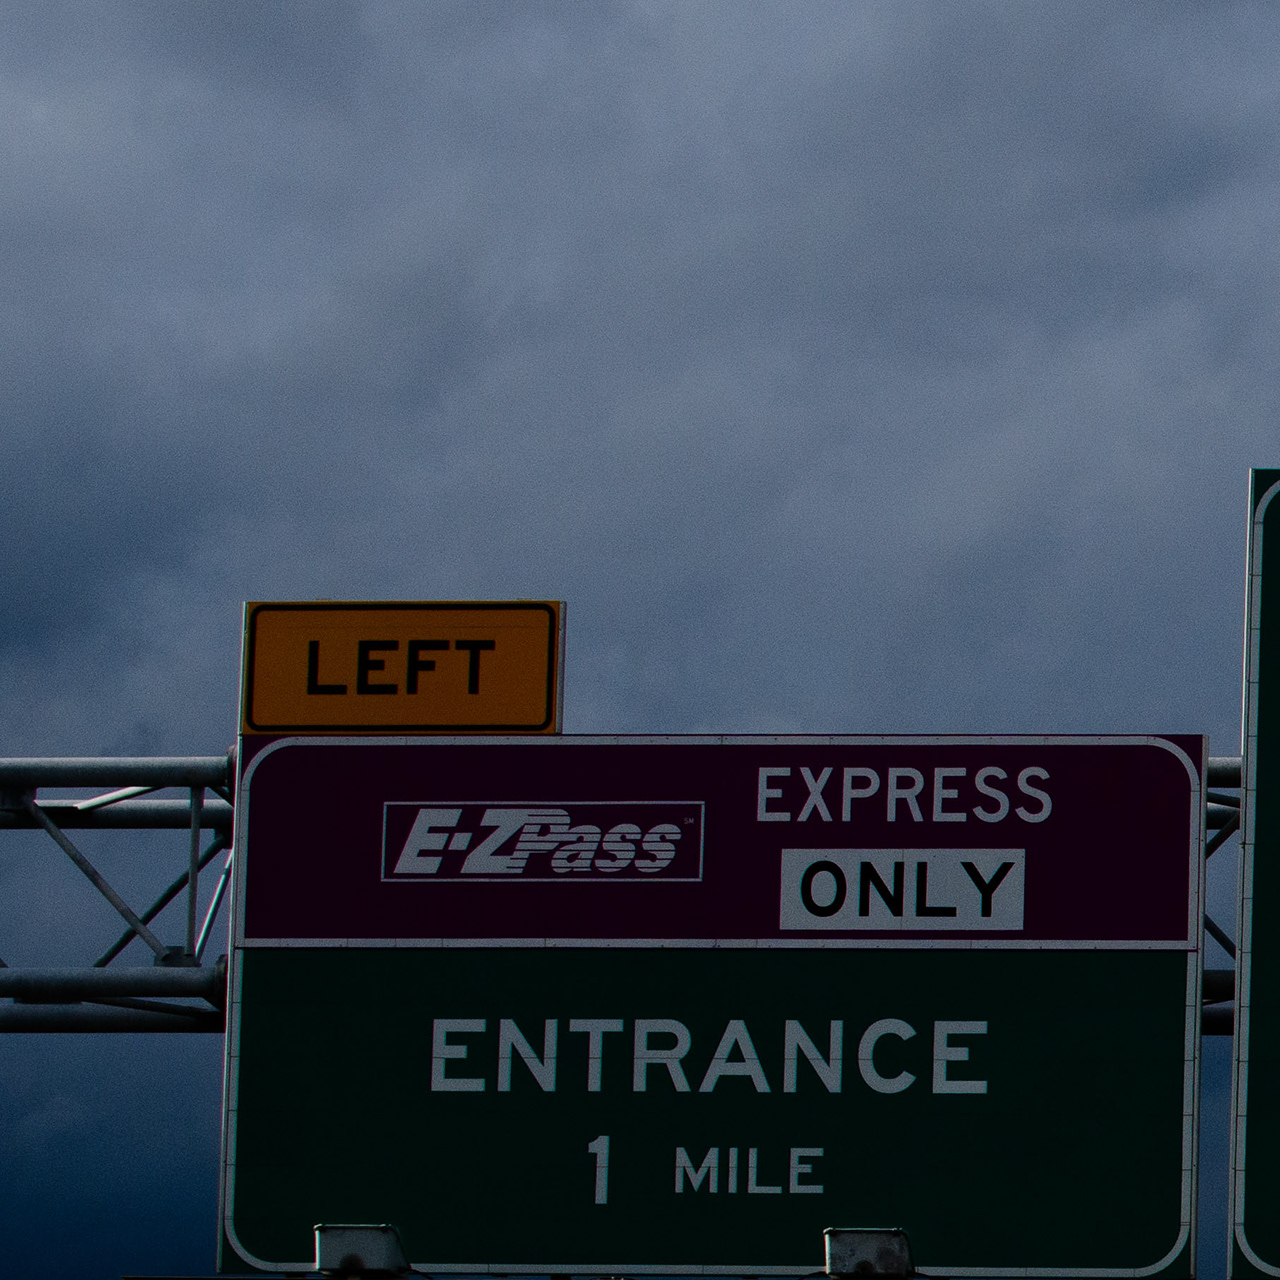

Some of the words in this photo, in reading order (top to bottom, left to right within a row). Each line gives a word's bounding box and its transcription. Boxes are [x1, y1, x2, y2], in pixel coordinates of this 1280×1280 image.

[307, 640, 495, 695] LEFT
[757, 767, 1052, 823] EXPRESS
[393, 809, 681, 875] E-ZPass
[801, 861, 1014, 917] ONLY
[431, 1019, 986, 1093] ENTRANCE
[588, 1136, 607, 1203] 1
[675, 1147, 822, 1193] MILE
